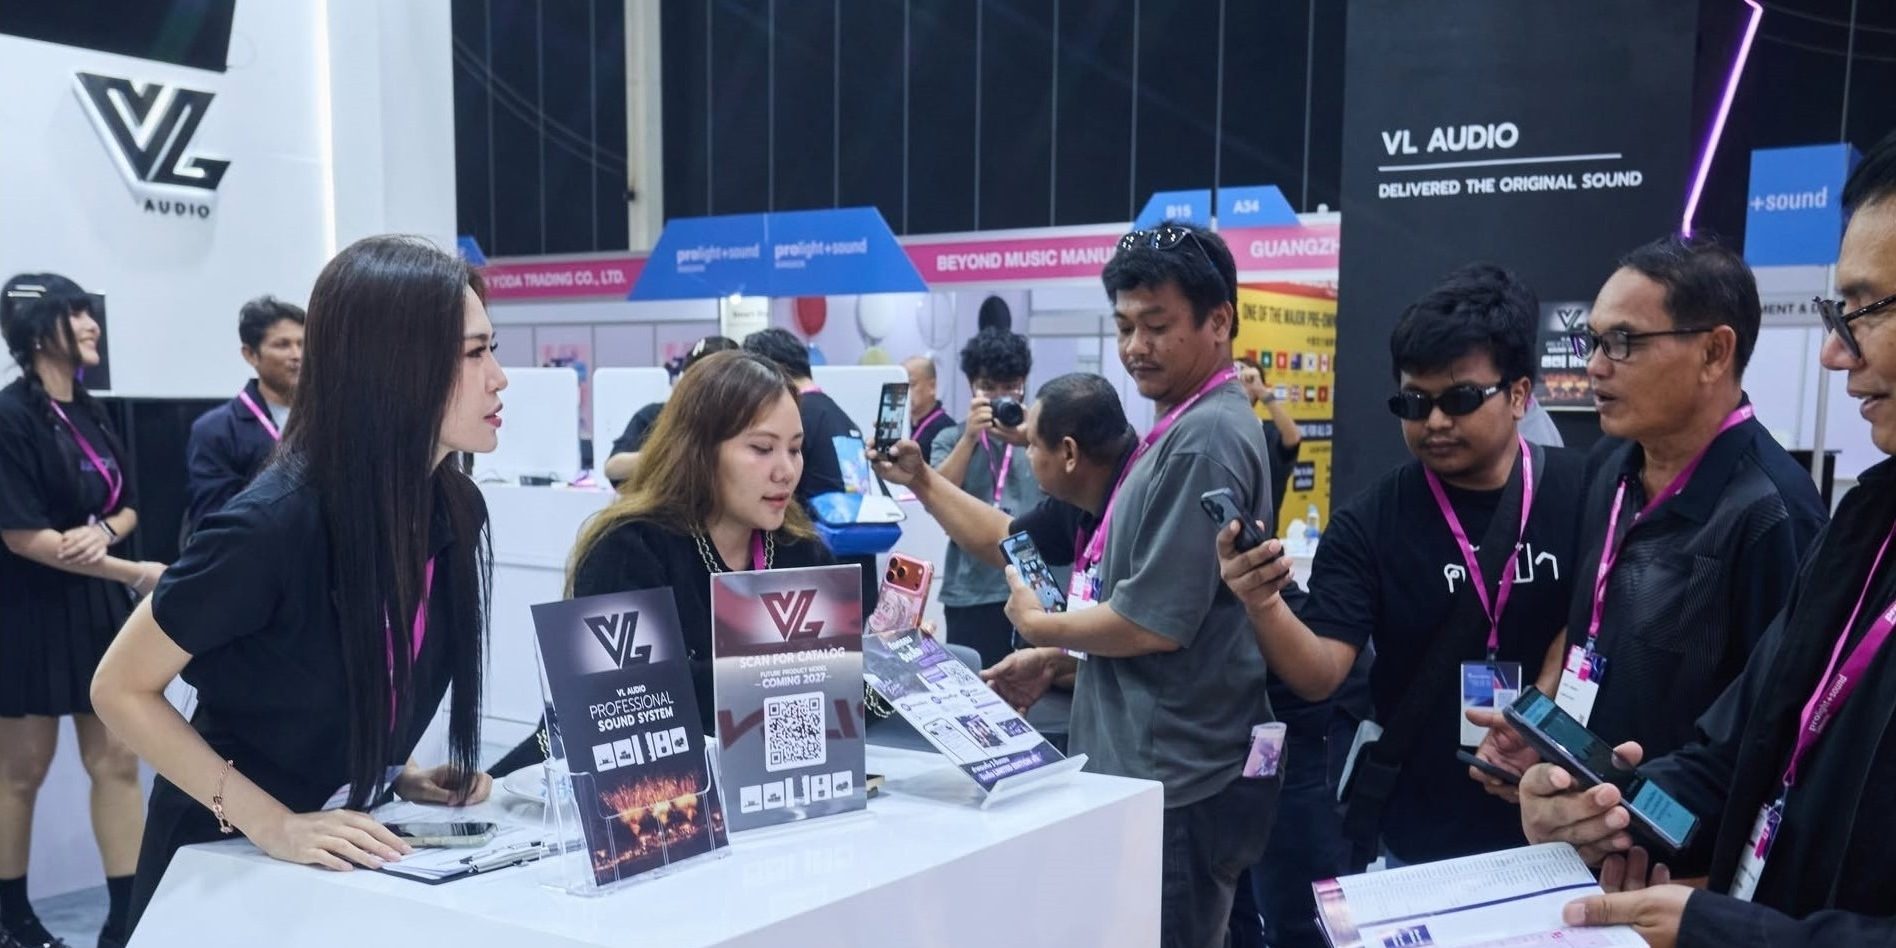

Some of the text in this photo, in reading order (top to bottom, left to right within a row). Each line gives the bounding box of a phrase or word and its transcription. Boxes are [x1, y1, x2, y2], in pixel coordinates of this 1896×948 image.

[1381, 121, 1519, 156] VL AUDIO
[1378, 170, 1643, 199] DELIVERED THE ORIGINAL SOUND
[143, 199, 211, 219] AUDIO
[936, 252, 1002, 272] BEYOND
[1004, 247, 1058, 268] MUSIC
[523, 271, 574, 288] TRADING
[740, 646, 846, 669] SCAN FOR CATALOG
[616, 684, 647, 697] VL AUDIO
[589, 690, 674, 719] PROFESSIONAL
[597, 706, 674, 732] SOUND SYSTEM
